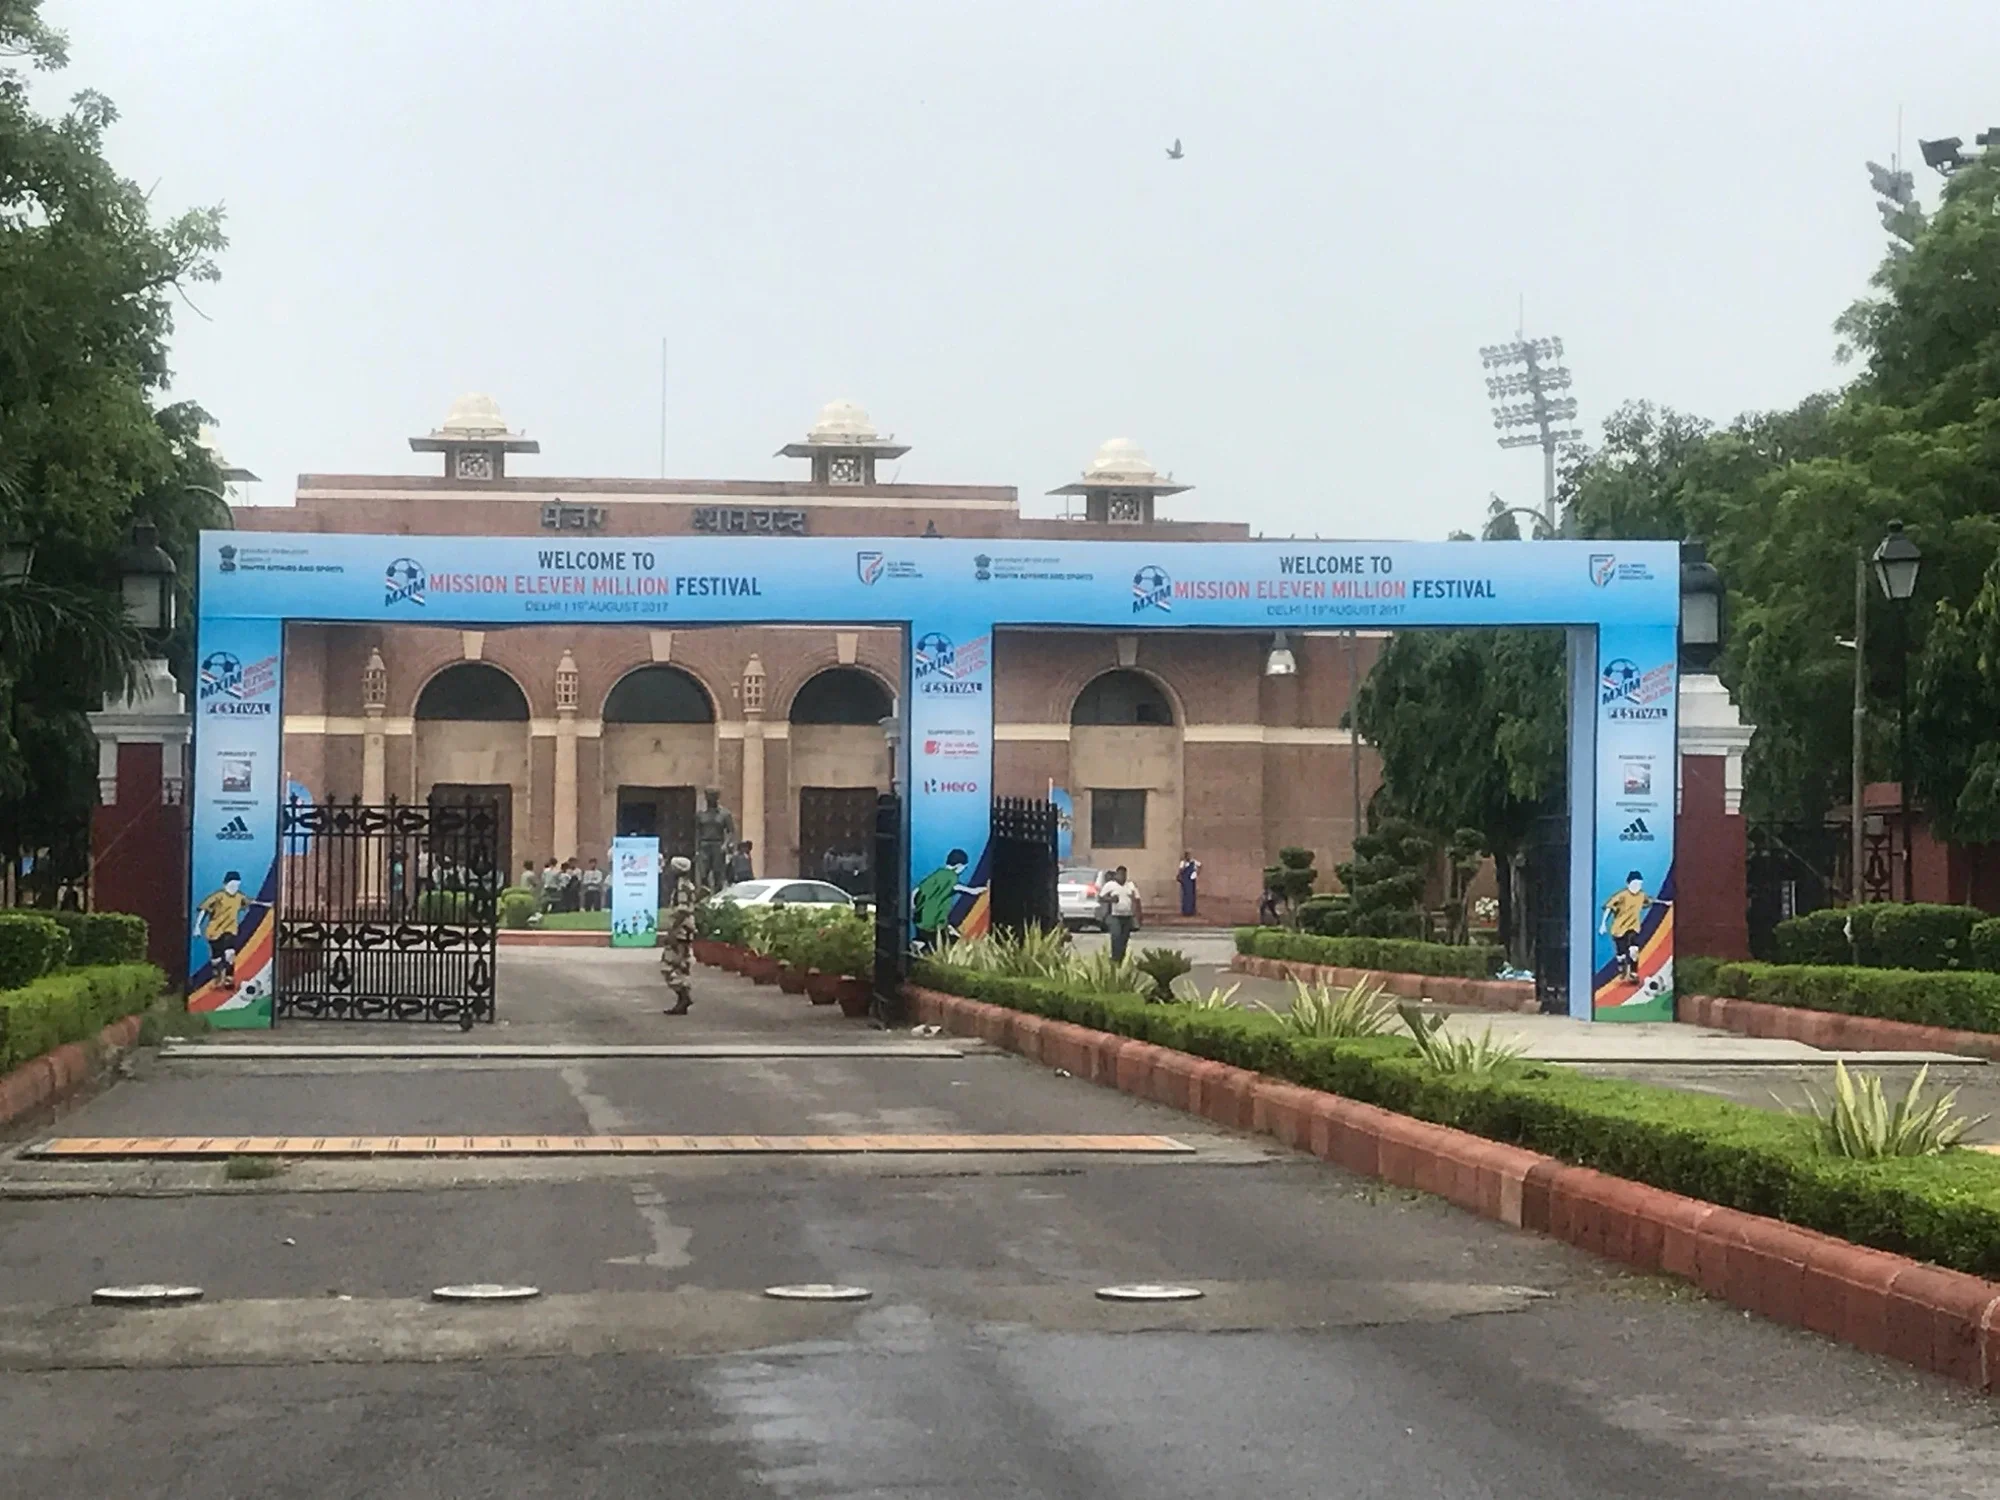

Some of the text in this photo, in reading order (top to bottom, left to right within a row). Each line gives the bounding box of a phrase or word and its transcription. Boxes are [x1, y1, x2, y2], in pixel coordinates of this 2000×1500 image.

[538, 551, 655, 570] WELCOME TO
[1280, 556, 1392, 574] WELCOME TO
[429, 574, 762, 596] MISSION ELEVEN MILLION FESTIVAL
[1174, 580, 1496, 599] MISSION ELEVEN MILLION FESTIVAL
[642, 601, 669, 613] 2017
[915, 651, 954, 679] MXIM
[200, 671, 242, 699] MXIM
[922, 682, 982, 694] FESTIVAL
[1602, 677, 1640, 705] MXIM
[207, 702, 271, 714] FESTIVAL
[1608, 708, 1668, 719] FESTIVAL
